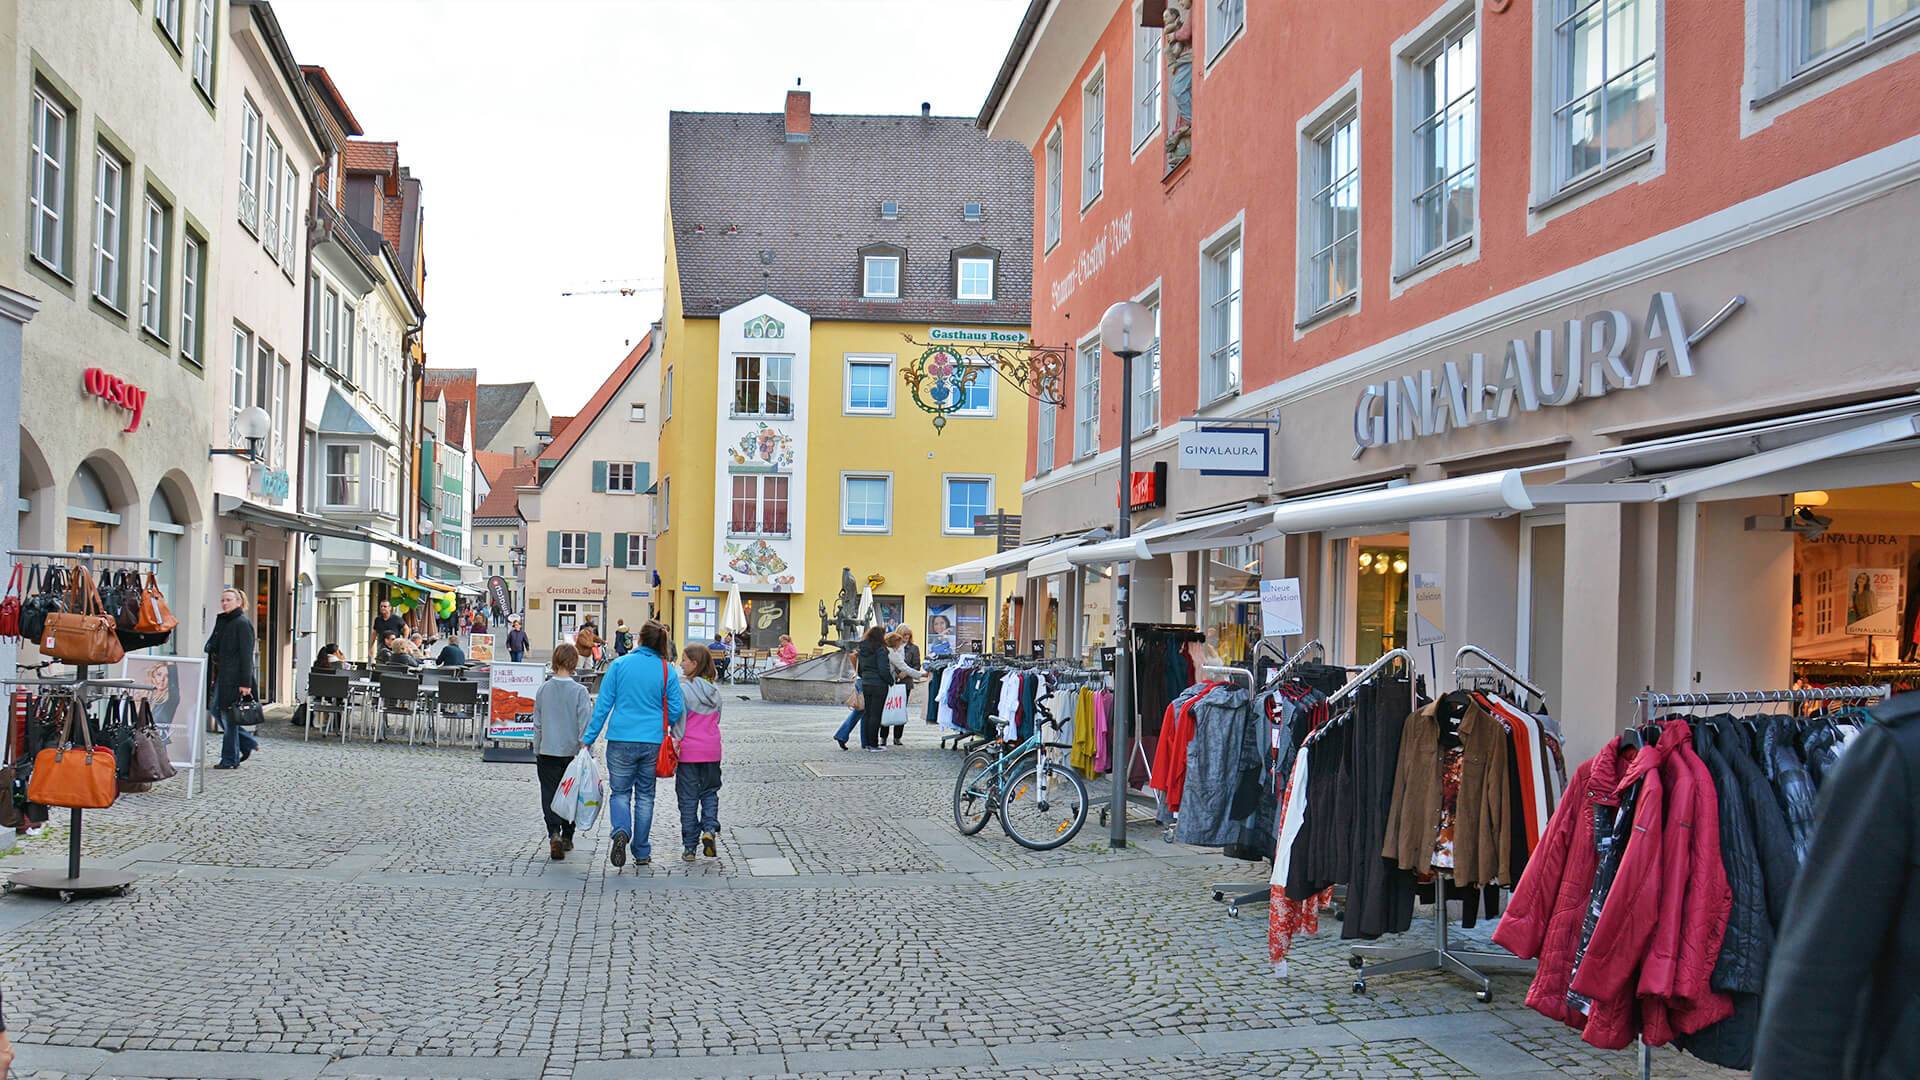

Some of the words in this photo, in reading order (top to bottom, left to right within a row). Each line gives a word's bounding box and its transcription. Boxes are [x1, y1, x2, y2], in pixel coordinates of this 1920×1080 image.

[1111, 208, 1133, 256] Rose
[932, 329, 987, 341] Gasthaus
[991, 331, 1018, 341] Rose
[1354, 291, 1696, 448] GINALAURA
[84, 367, 148, 433] orsay
[1185, 445, 1258, 456] GINALAURA
[546, 586, 581, 595] Crescentia
[582, 586, 612, 596] Apothee
[1271, 583, 1291, 592] Neue
[1262, 594, 1299, 603] Kollektion
